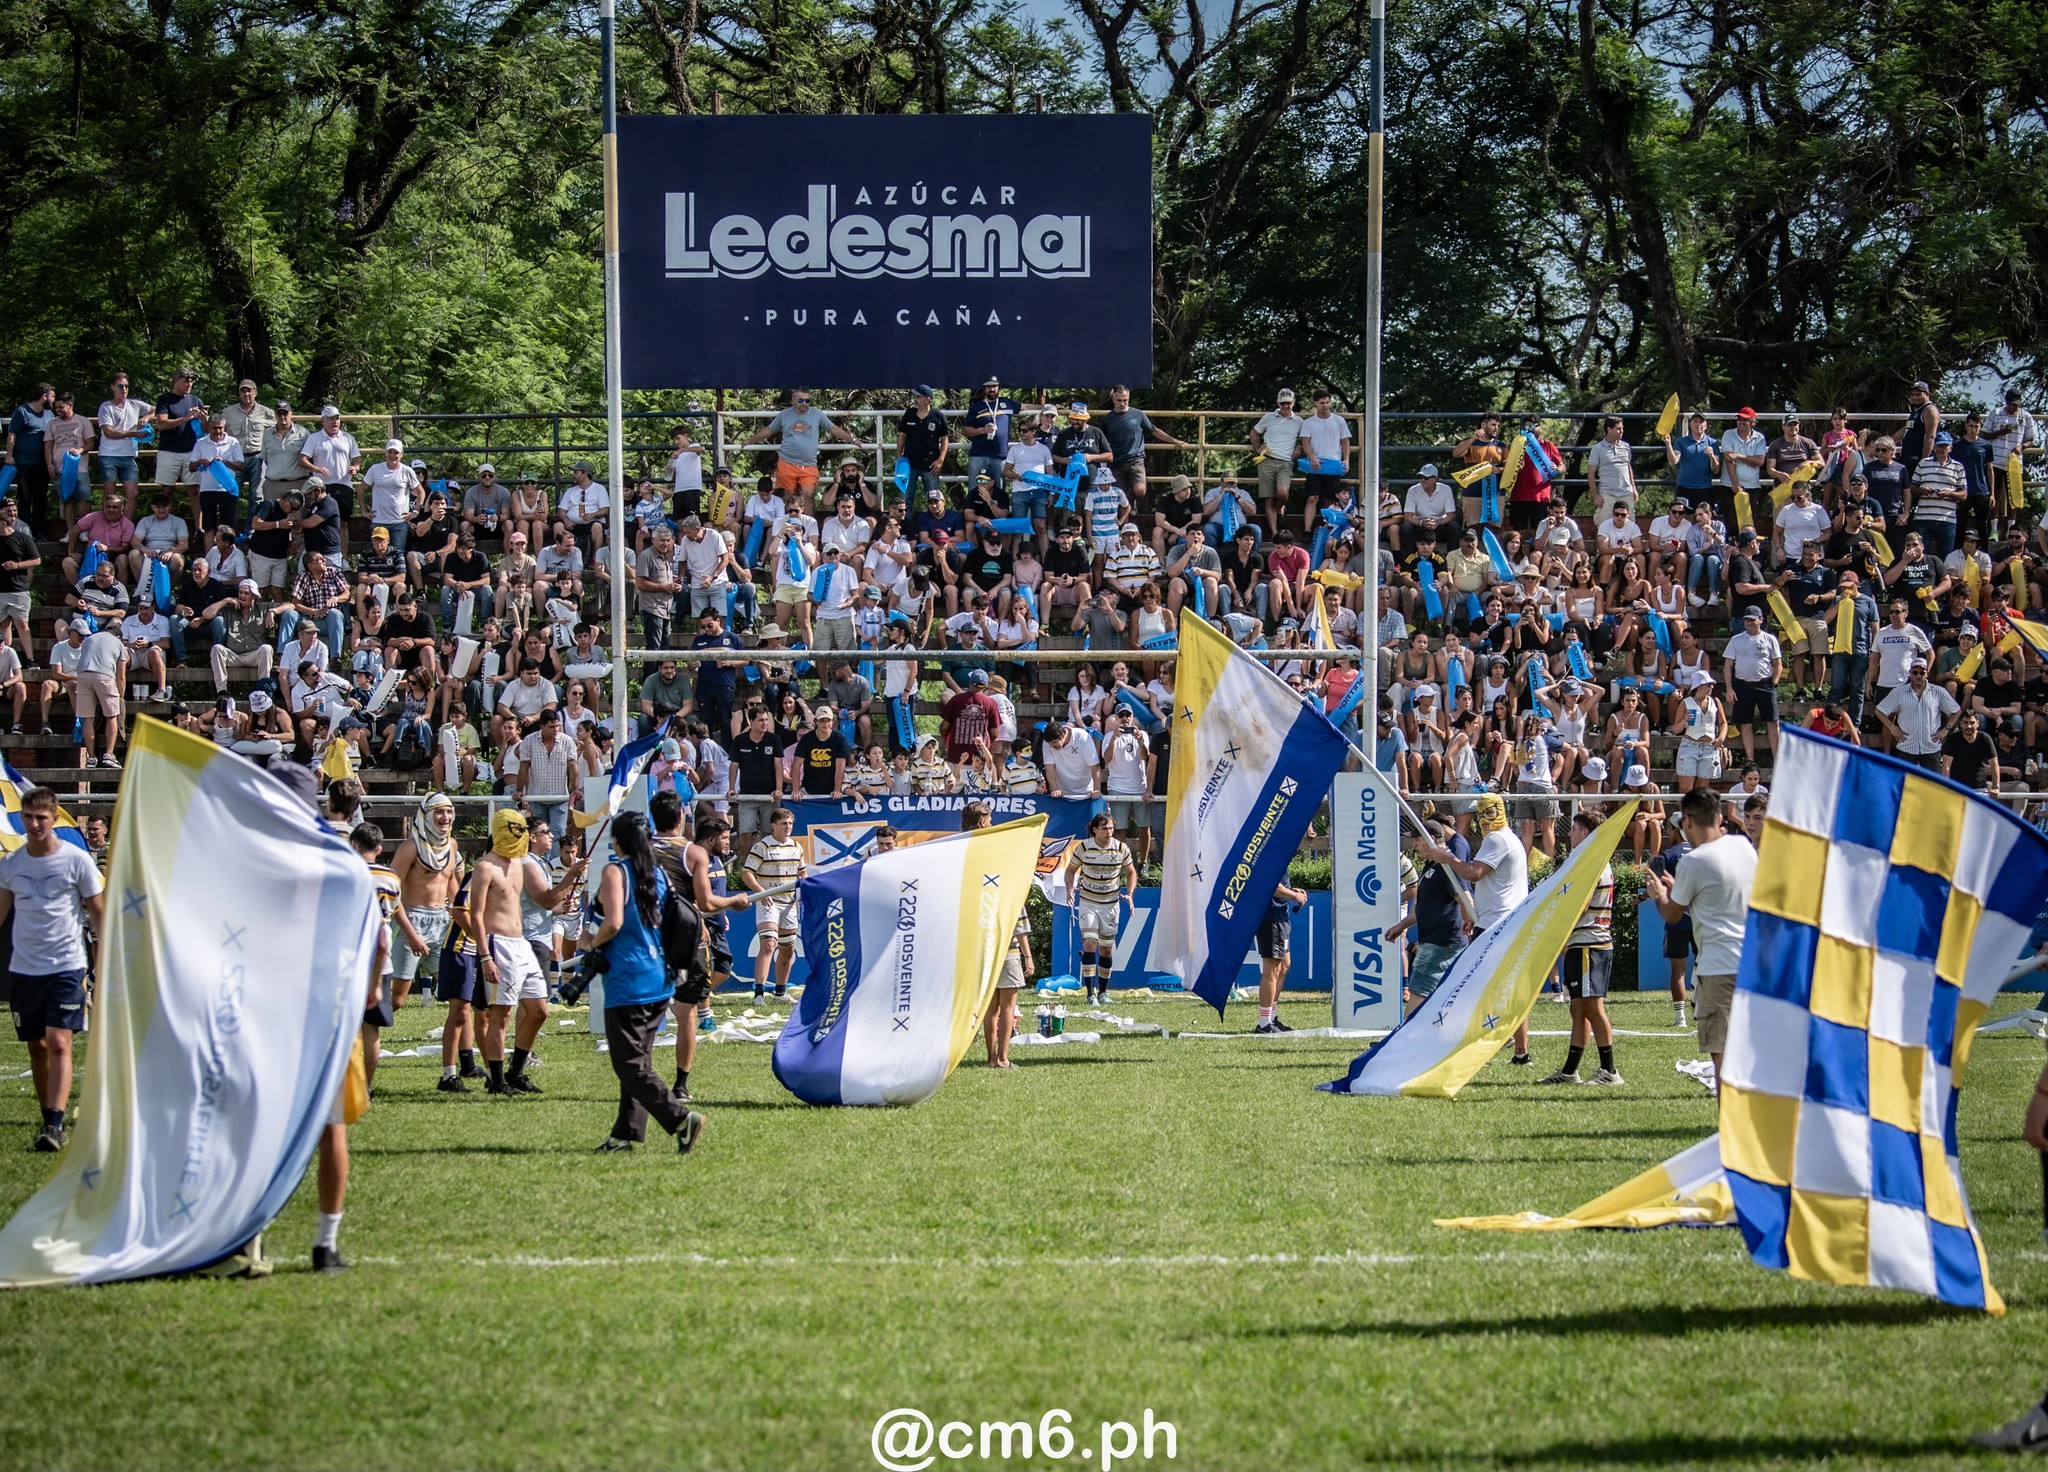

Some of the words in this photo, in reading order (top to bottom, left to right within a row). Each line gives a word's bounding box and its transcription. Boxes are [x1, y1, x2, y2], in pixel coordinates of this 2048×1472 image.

[855, 181, 1016, 205] AZÚCAR
[665, 184, 1091, 279] Ledesma
[766, 309, 867, 326] PURA
[897, 305, 1001, 326] CAÑA
[712, 489, 726, 521] ORTING
[547, 603, 564, 647] SPOTING
[1142, 638, 1177, 650] ORTING
[1573, 645, 1585, 677] PORTING
[841, 798, 882, 815] LOS
[1356, 786, 1377, 861] Macro
[1244, 793, 1286, 863] DOSVEINTE
[897, 895, 917, 931] 220
[827, 917, 846, 958] 220
[898, 934, 915, 1012] DOSVEINTE
[1352, 927, 1384, 1018] VISA
